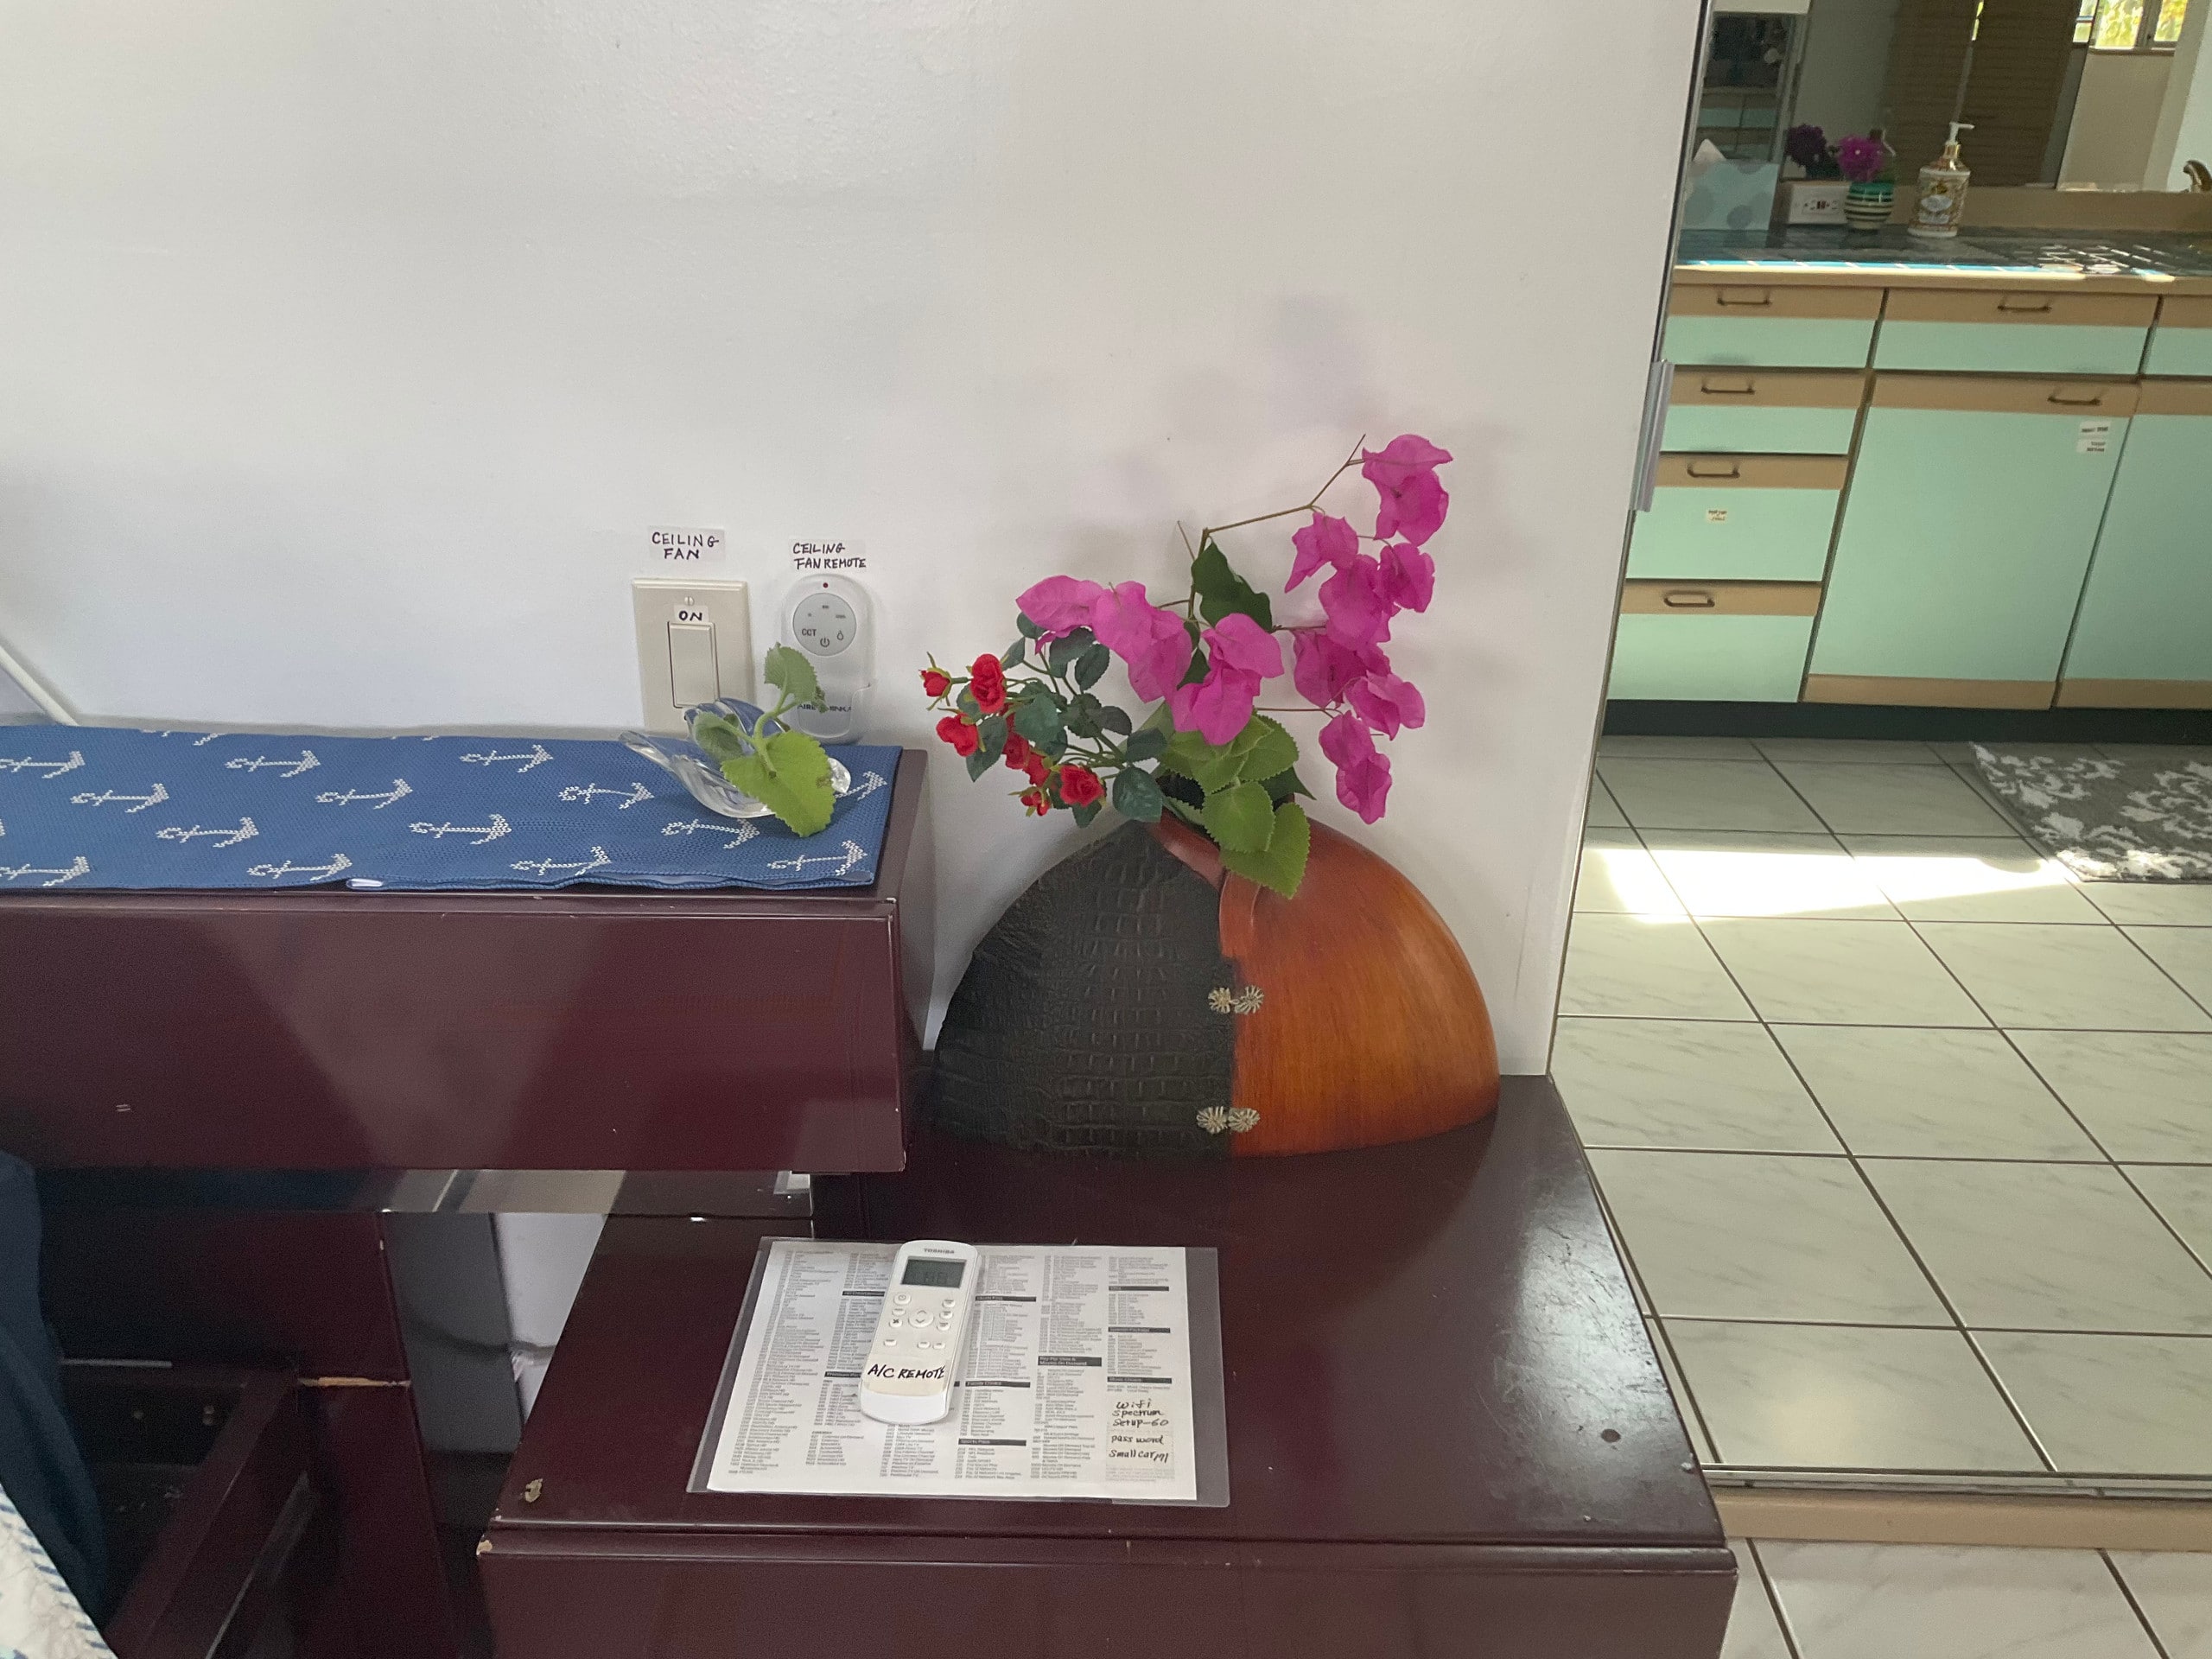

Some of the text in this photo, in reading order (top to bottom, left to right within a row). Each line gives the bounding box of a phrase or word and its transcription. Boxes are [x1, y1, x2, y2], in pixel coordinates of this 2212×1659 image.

[652, 531, 719, 547] CEILING
[664, 548, 700, 560] FAN
[792, 543, 845, 555] CEILING
[794, 557, 867, 569] FAN REMOTE
[678, 610, 702, 621] ON
[868, 1363, 894, 1378] A/C
[898, 1365, 946, 1380] REMOTE
